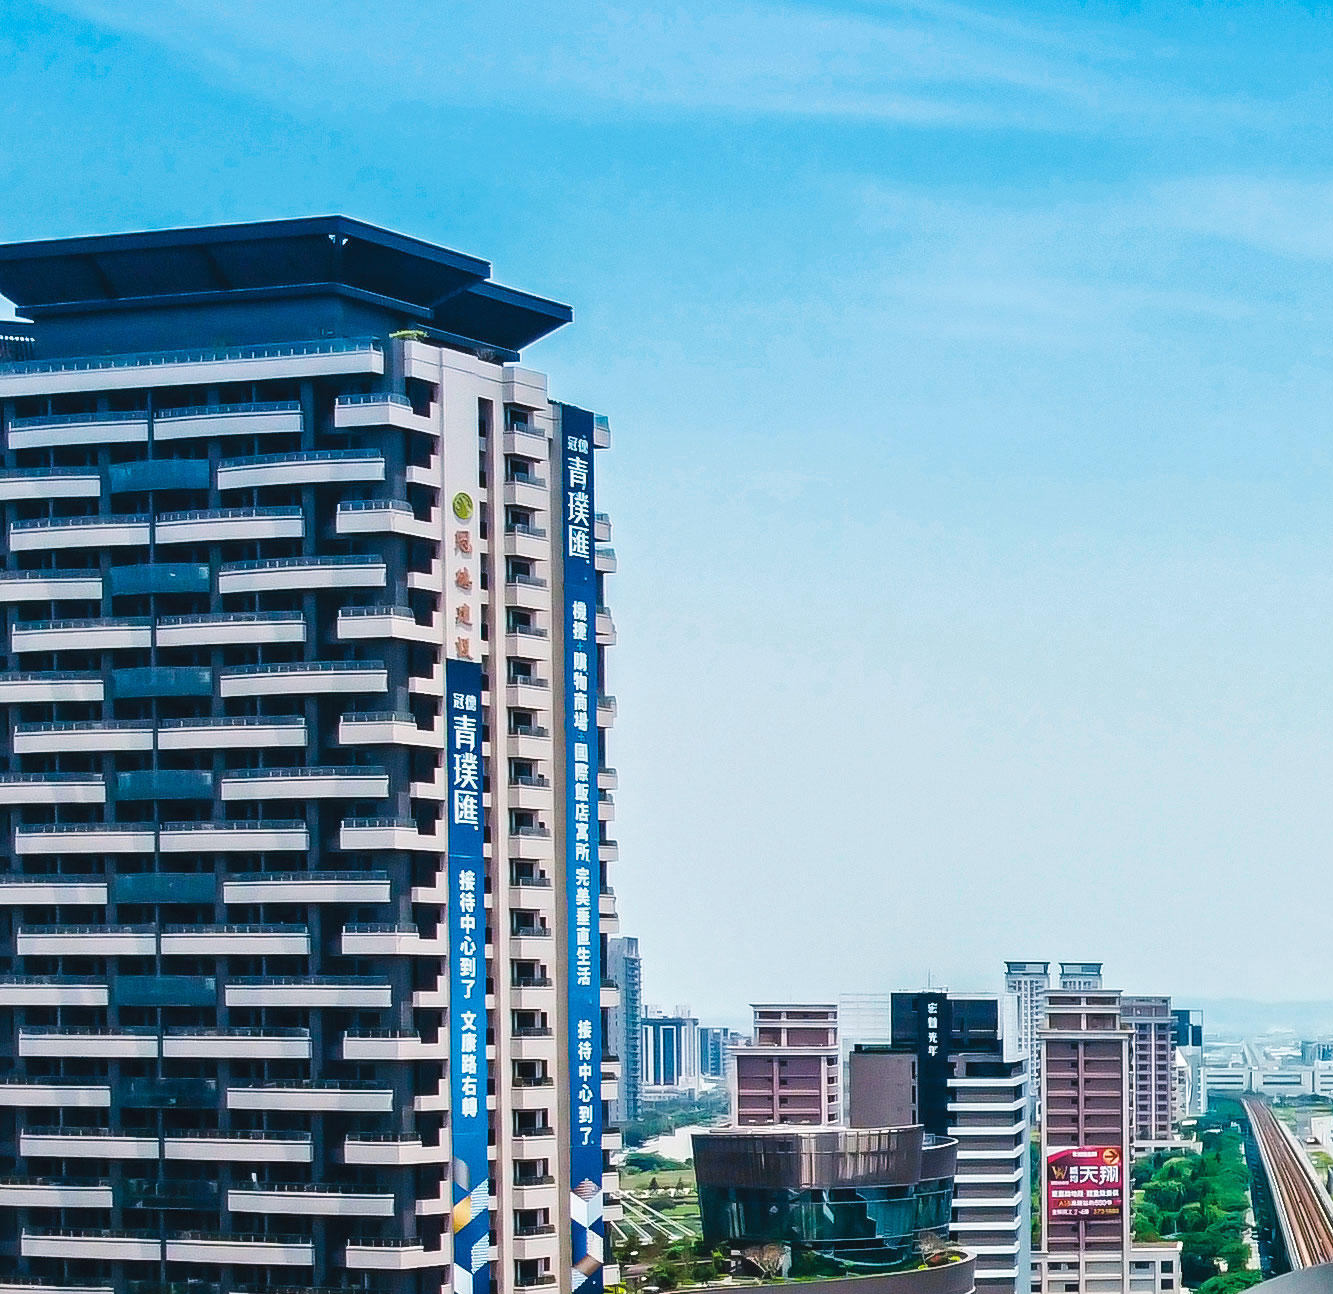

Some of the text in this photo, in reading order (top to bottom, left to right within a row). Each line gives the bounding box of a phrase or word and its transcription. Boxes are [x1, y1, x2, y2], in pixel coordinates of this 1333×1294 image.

[567, 456, 590, 559] 青璞匯
[453, 692, 477, 712] 冠德
[453, 715, 479, 825] 青璞匯
[459, 869, 477, 999] 接待中心到了
[575, 867, 592, 986] 完美垂直生活
[577, 1019, 594, 1146] 接待中心到了
